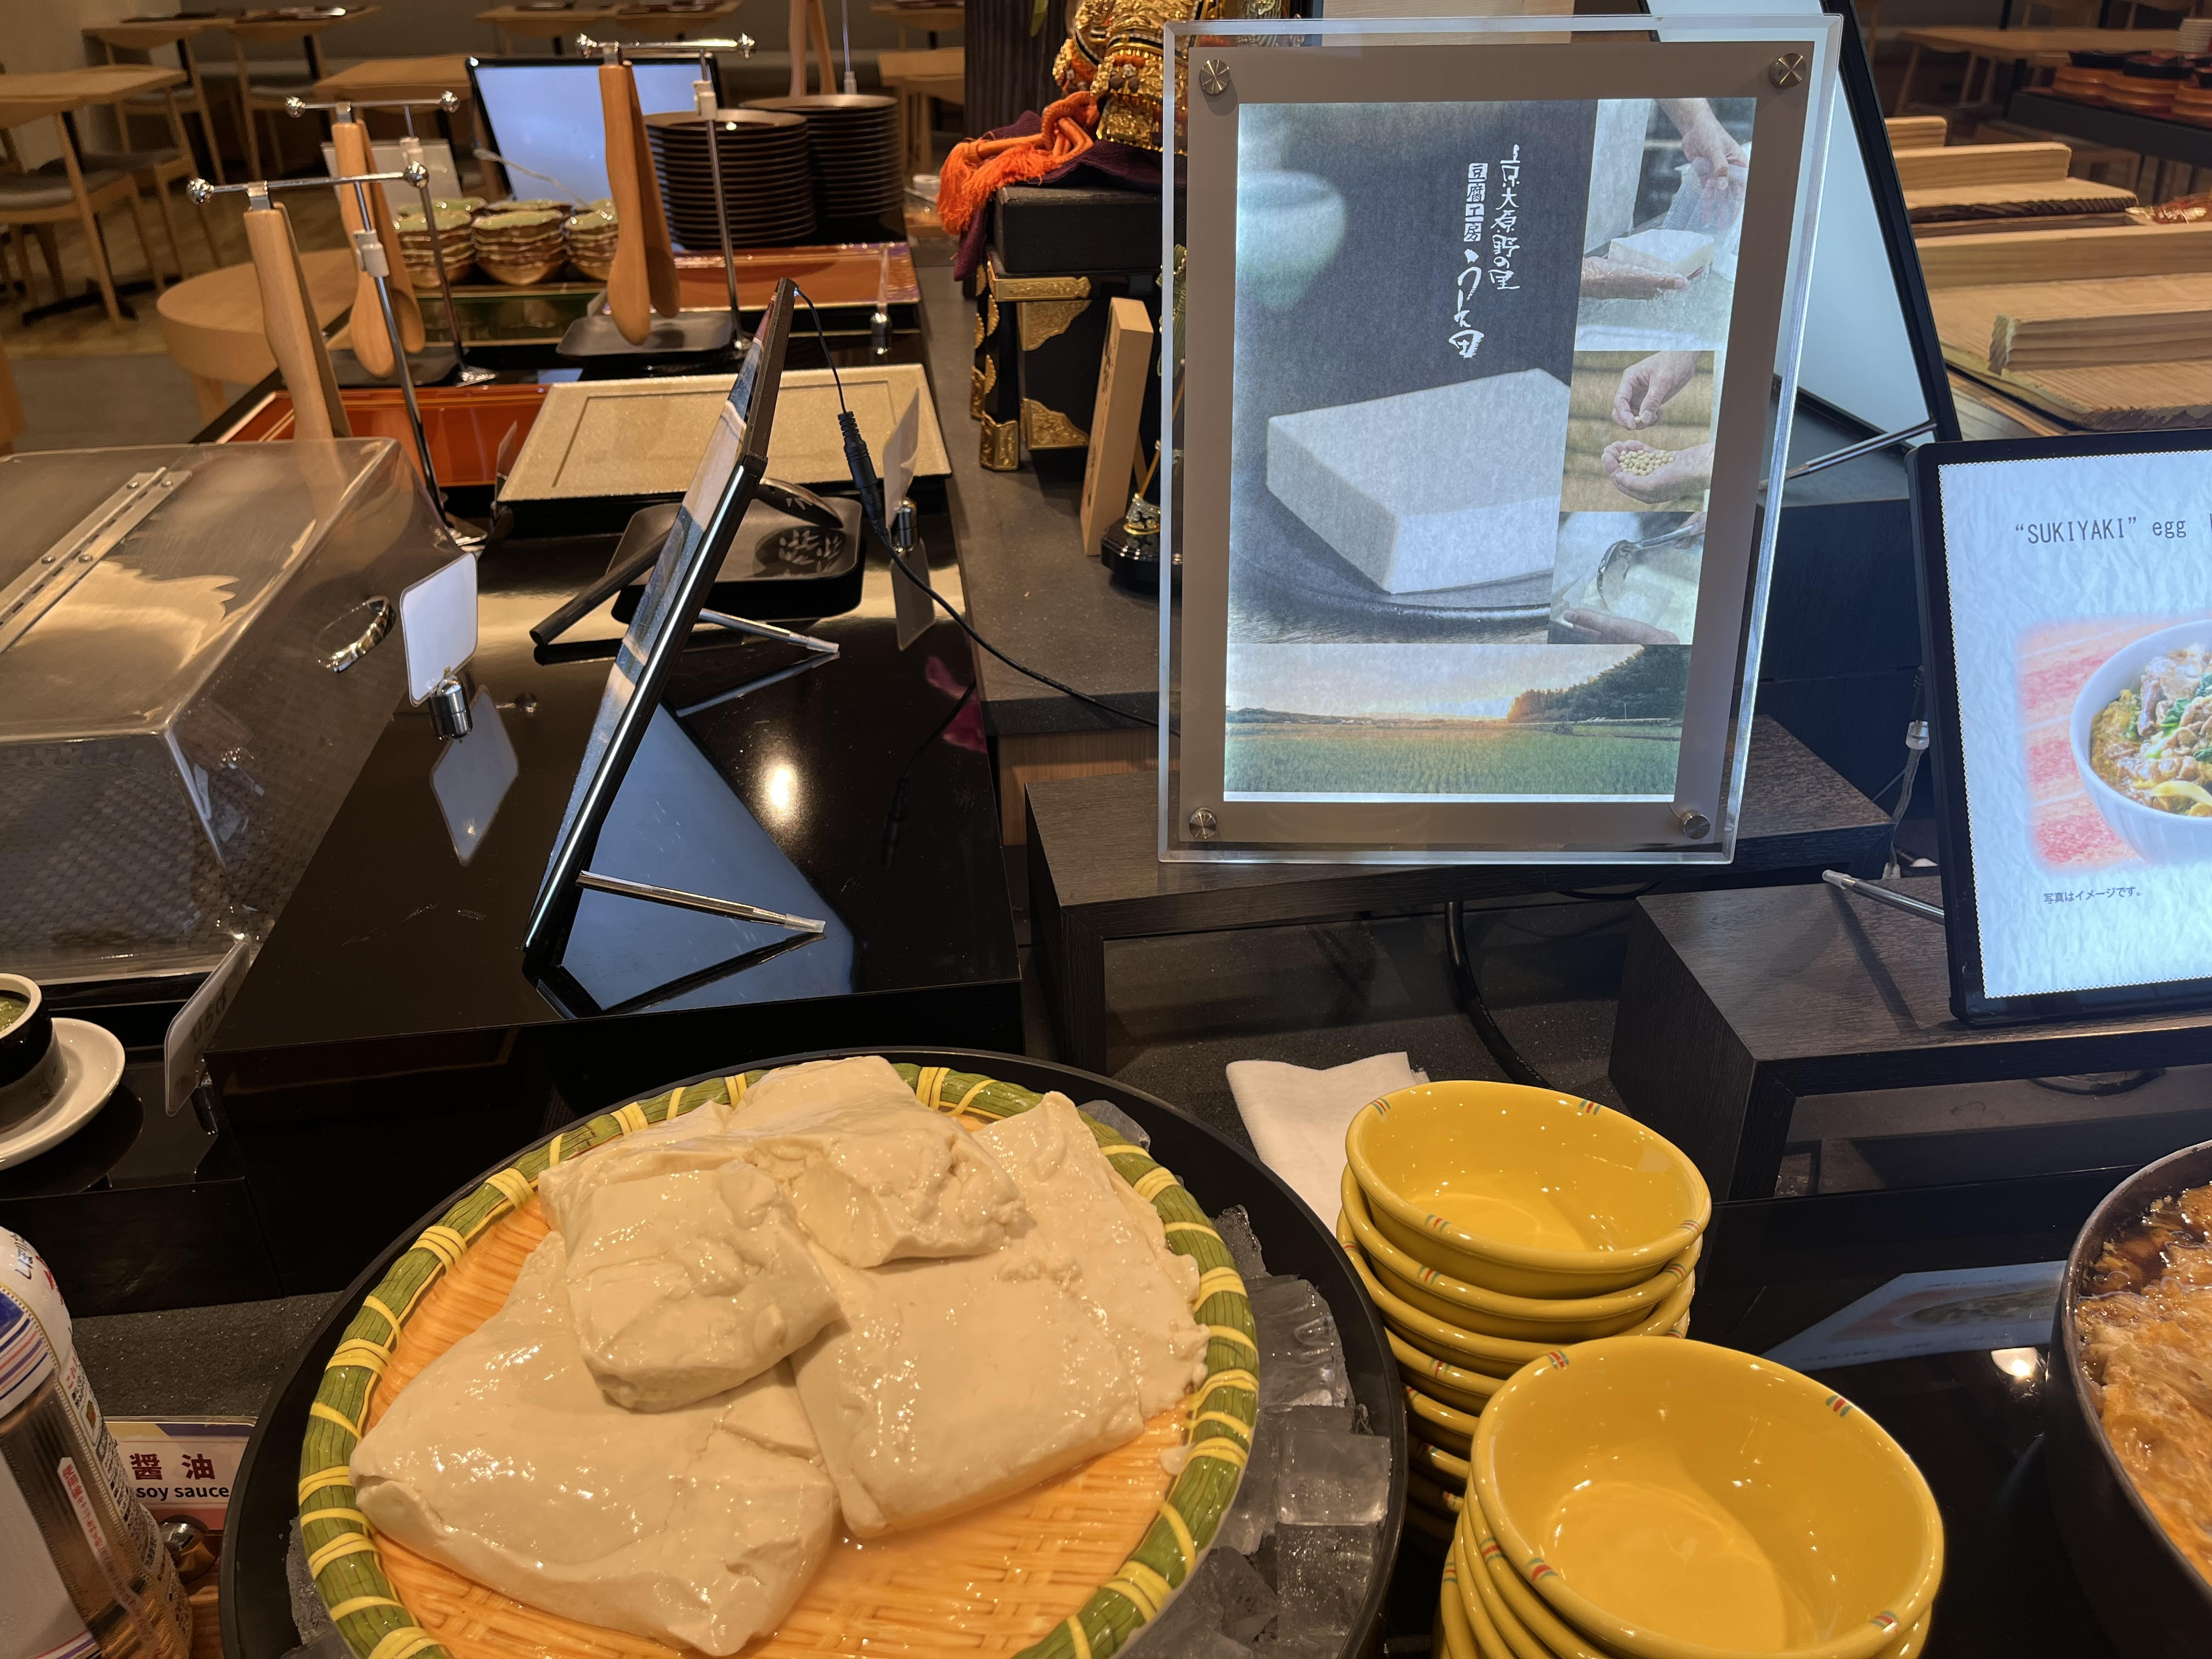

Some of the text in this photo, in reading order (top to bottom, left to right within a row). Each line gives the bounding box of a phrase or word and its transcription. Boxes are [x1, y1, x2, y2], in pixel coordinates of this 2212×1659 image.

[1463, 163, 1488, 241] 豆腐工房
[2152, 520, 2187, 539] egg
[2043, 885, 2142, 904] 写真はイメージです。
[137, 1487, 229, 1501] soy sauce
